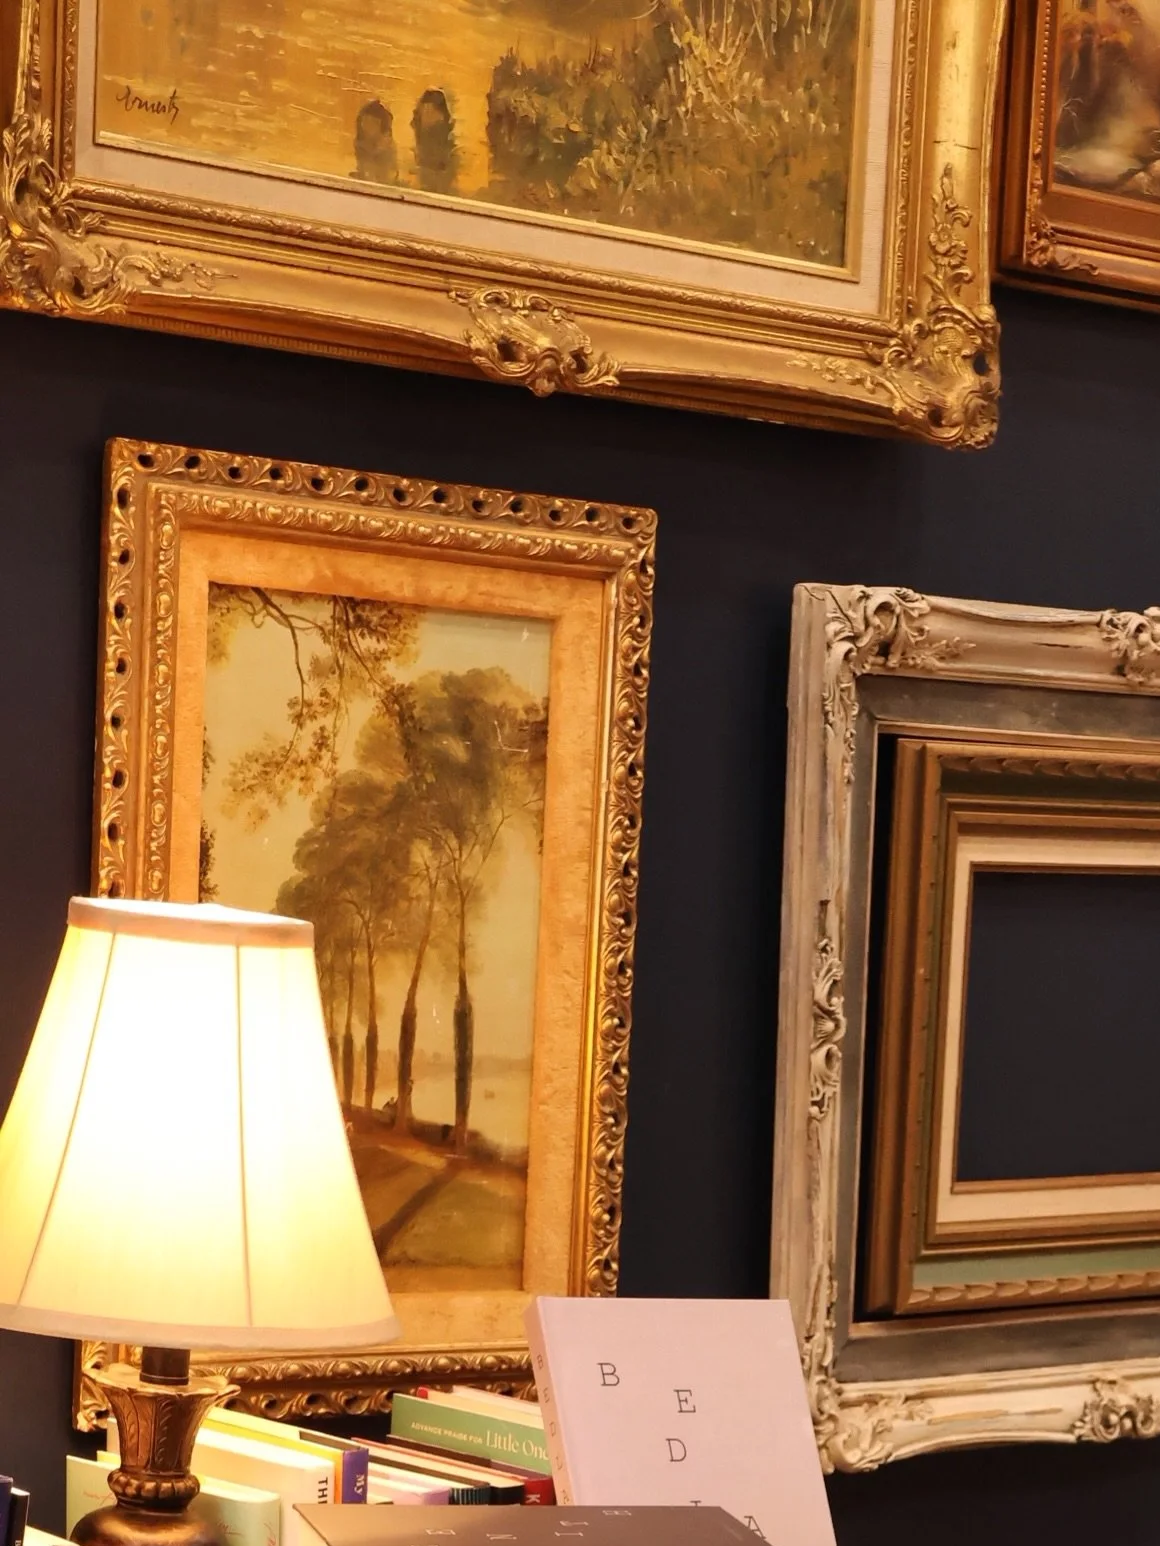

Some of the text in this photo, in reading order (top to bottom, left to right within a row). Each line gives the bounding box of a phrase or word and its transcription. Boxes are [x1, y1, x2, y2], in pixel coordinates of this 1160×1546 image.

[410, 1421, 520, 1454] ADVANCE PRAISE FOR Little
[354, 1473, 366, 1496] My
